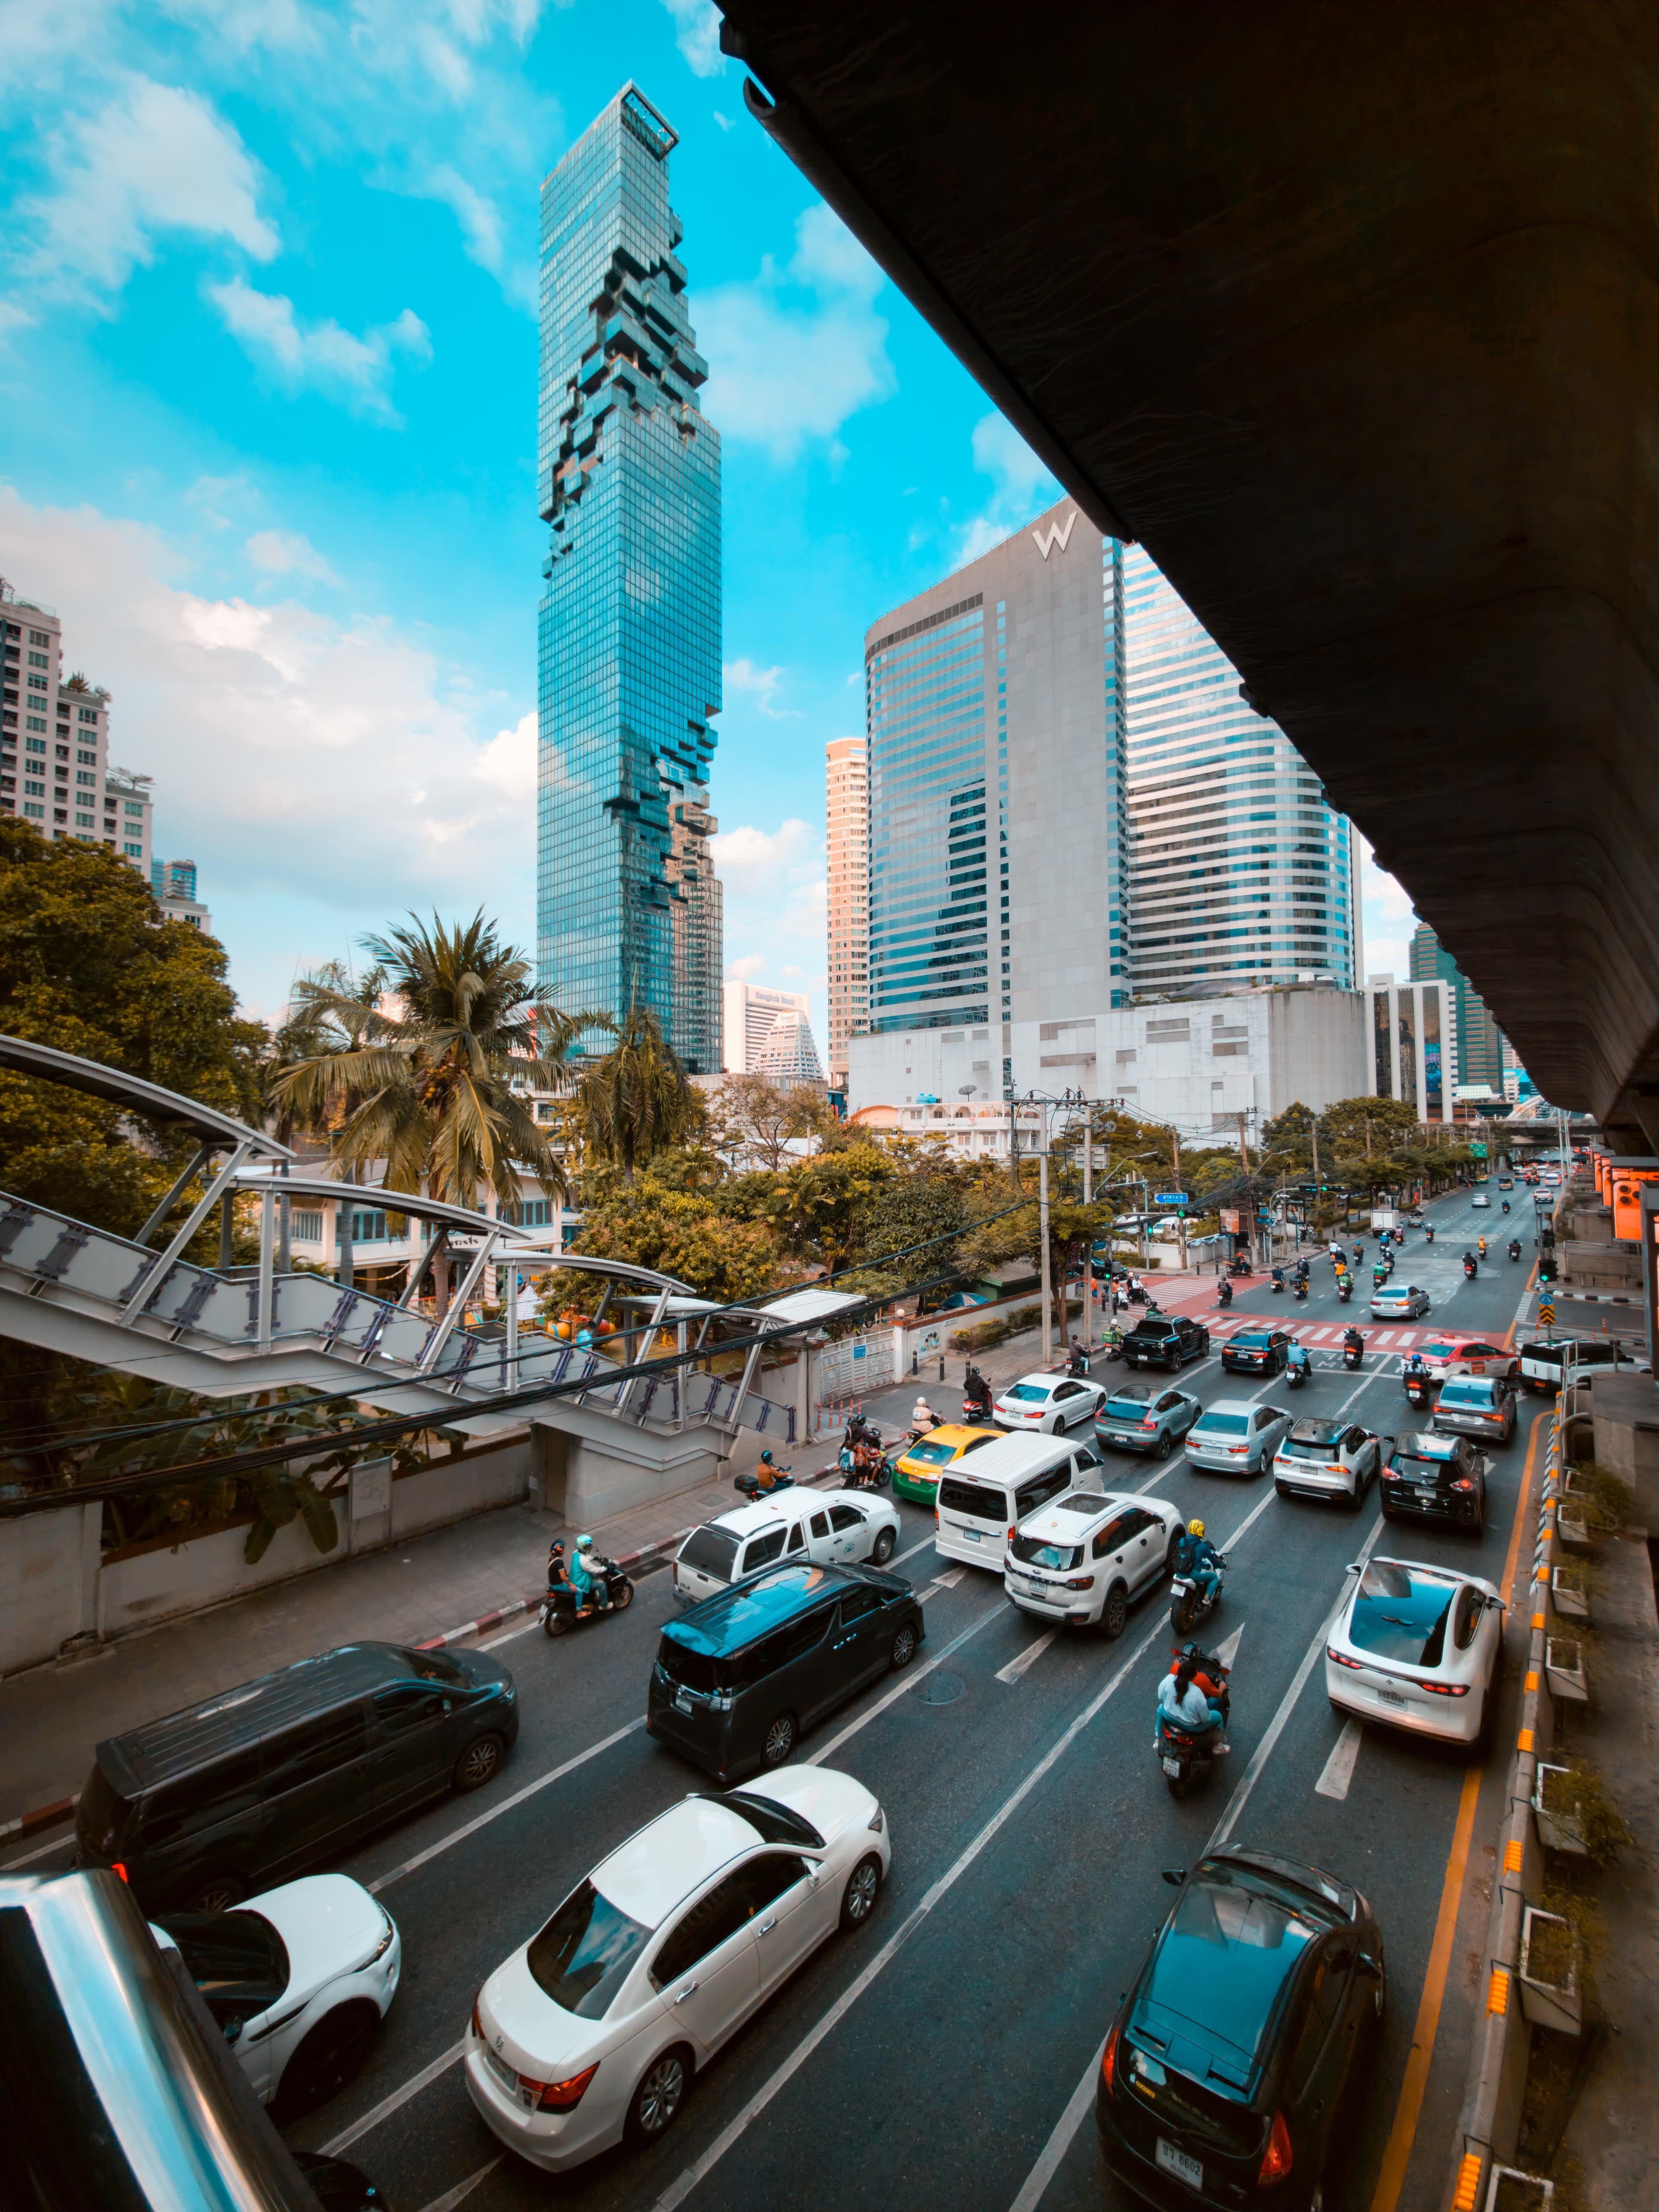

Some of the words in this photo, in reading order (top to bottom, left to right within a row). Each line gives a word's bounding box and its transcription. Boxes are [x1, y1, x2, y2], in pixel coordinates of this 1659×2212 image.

[1032, 512, 1077, 561] W
[755, 992, 780, 1003] Bangkok
[781, 996, 795, 1005] Bank
[1179, 2154, 1200, 2176] 6602
